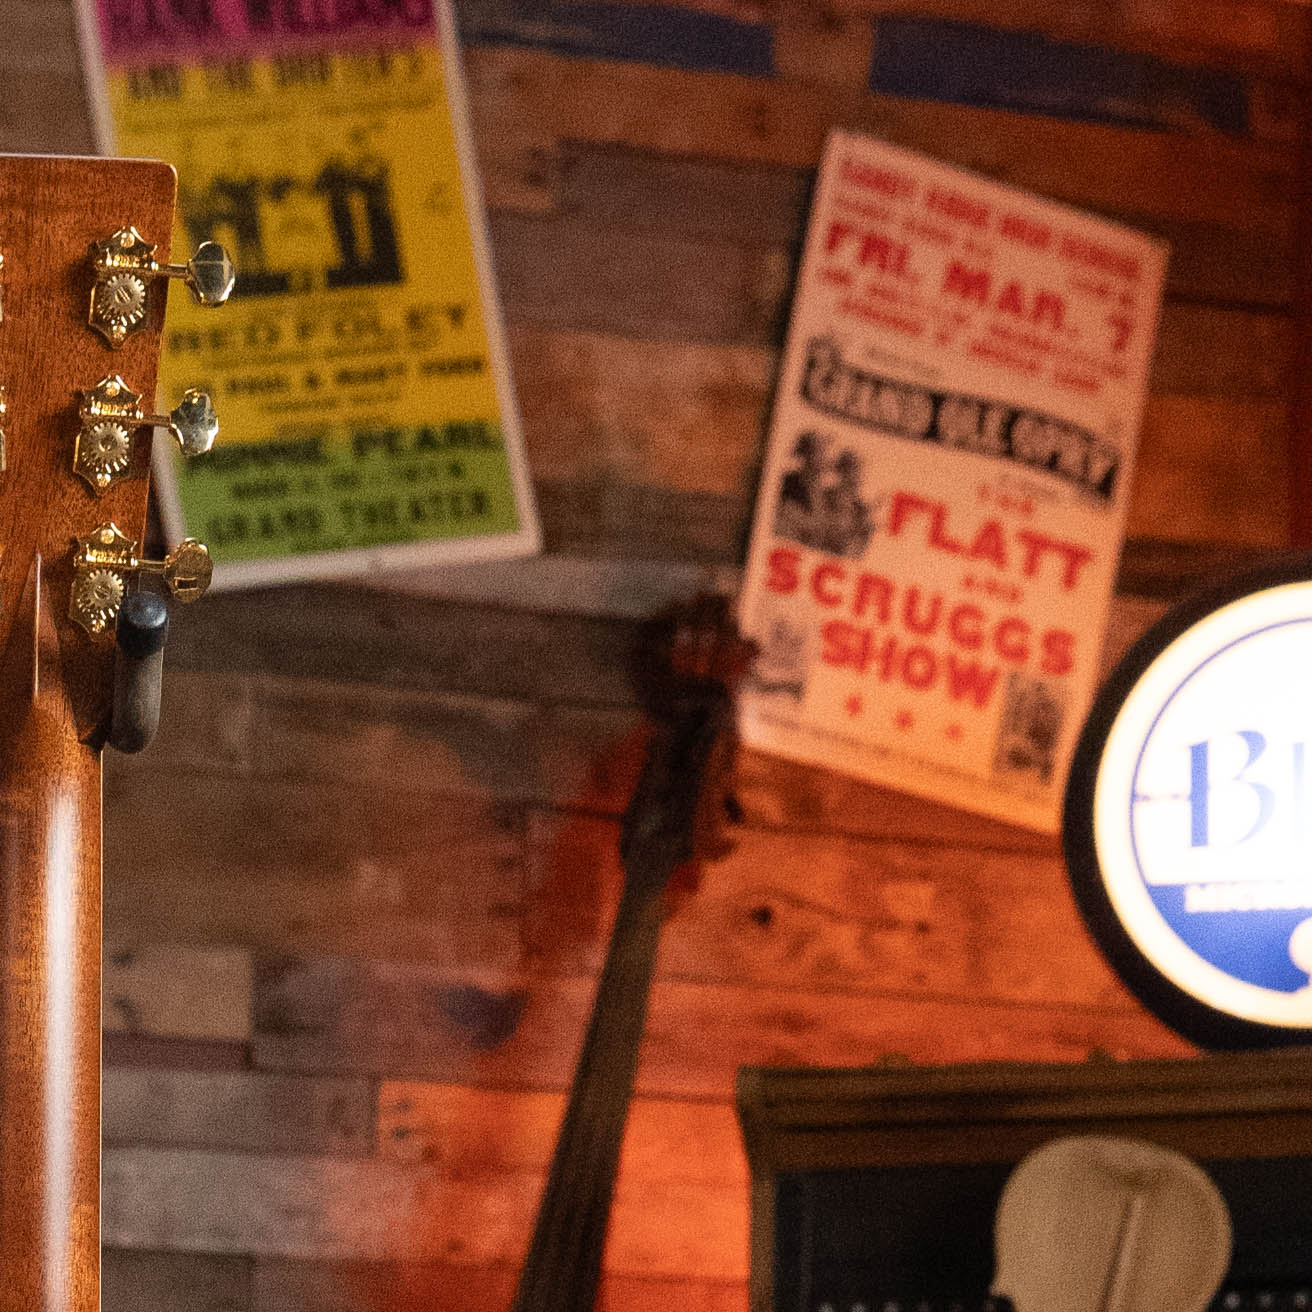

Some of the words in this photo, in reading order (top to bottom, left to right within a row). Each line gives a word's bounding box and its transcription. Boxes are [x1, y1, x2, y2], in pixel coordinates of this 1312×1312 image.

[887, 491, 1095, 593] FLATT
[765, 546, 1077, 678] SCRUGGS
[819, 617, 1001, 709] SHOW
